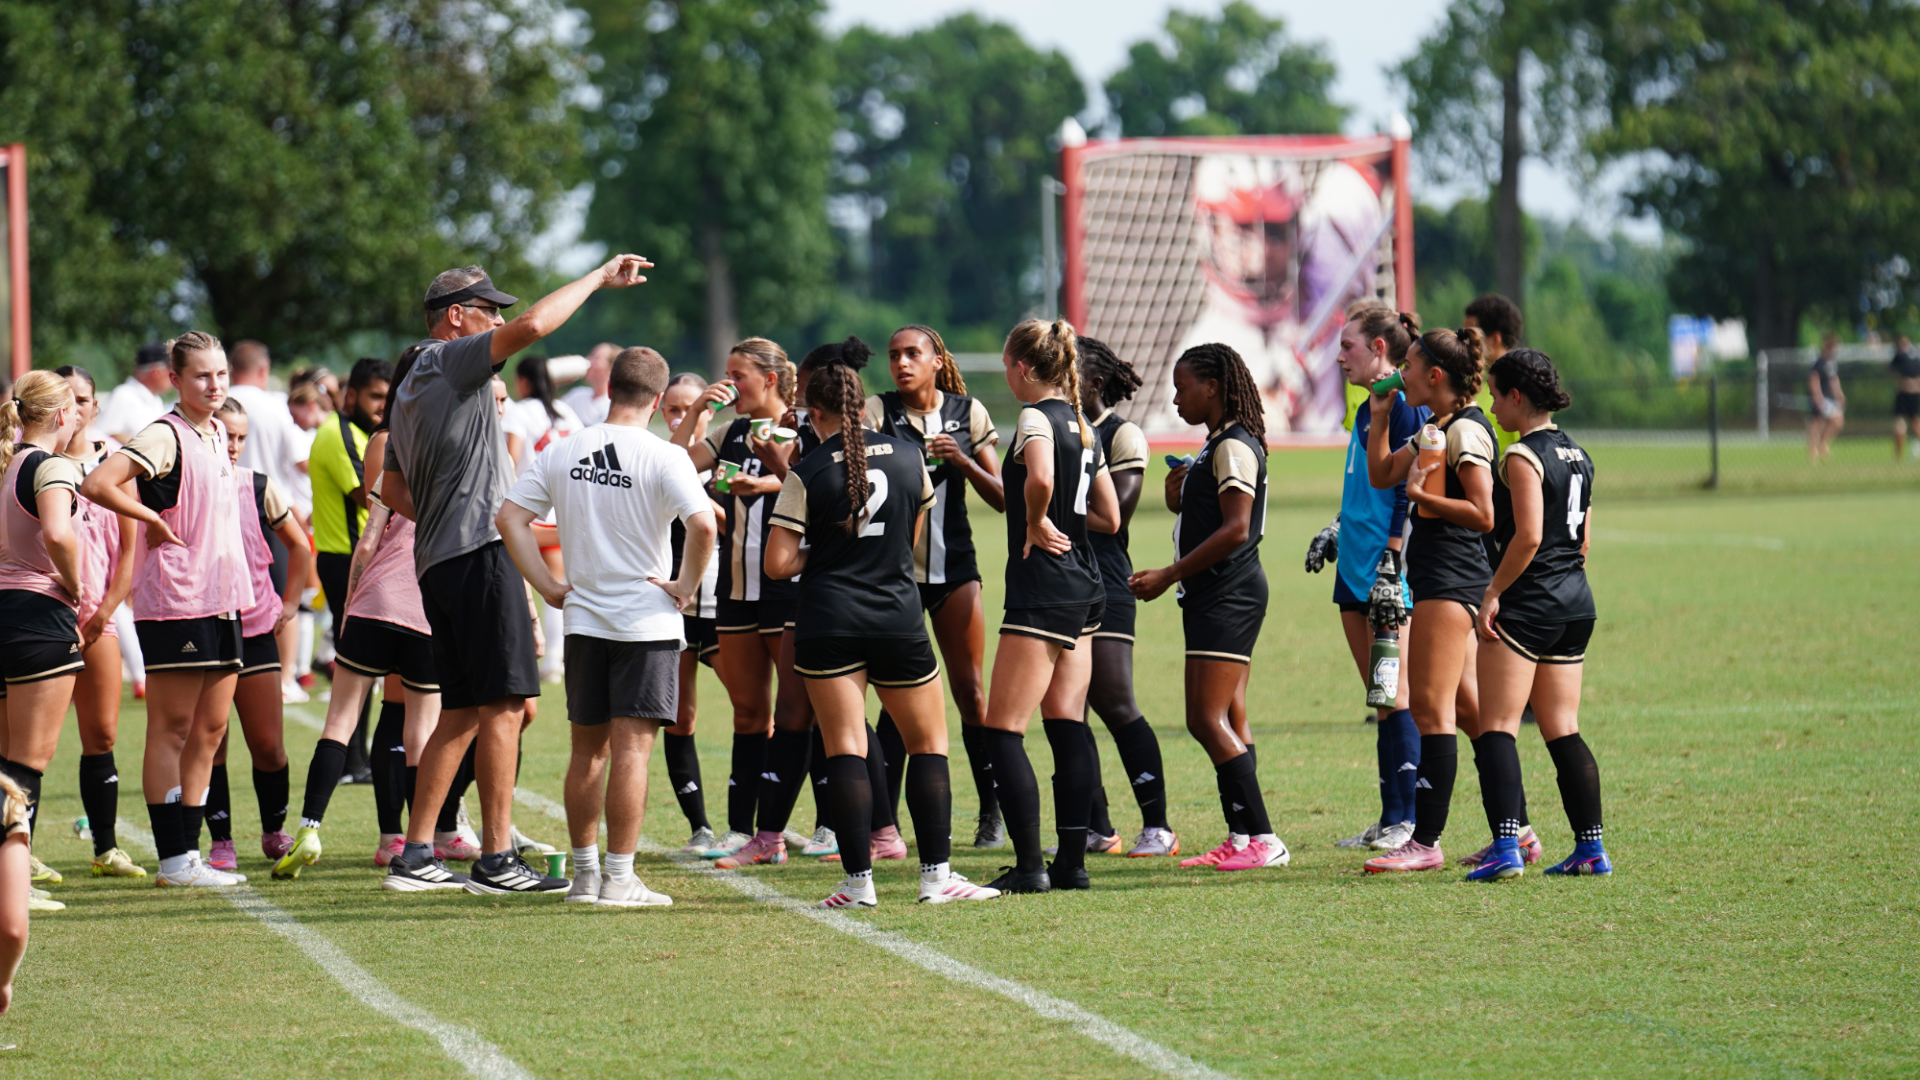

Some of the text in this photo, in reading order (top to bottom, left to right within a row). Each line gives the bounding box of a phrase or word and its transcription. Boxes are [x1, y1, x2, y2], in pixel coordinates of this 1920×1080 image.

[570, 467, 632, 489] adidas
[1347, 442, 1357, 474] 1
[858, 468, 888, 538] 2
[1566, 473, 1586, 540] 4
